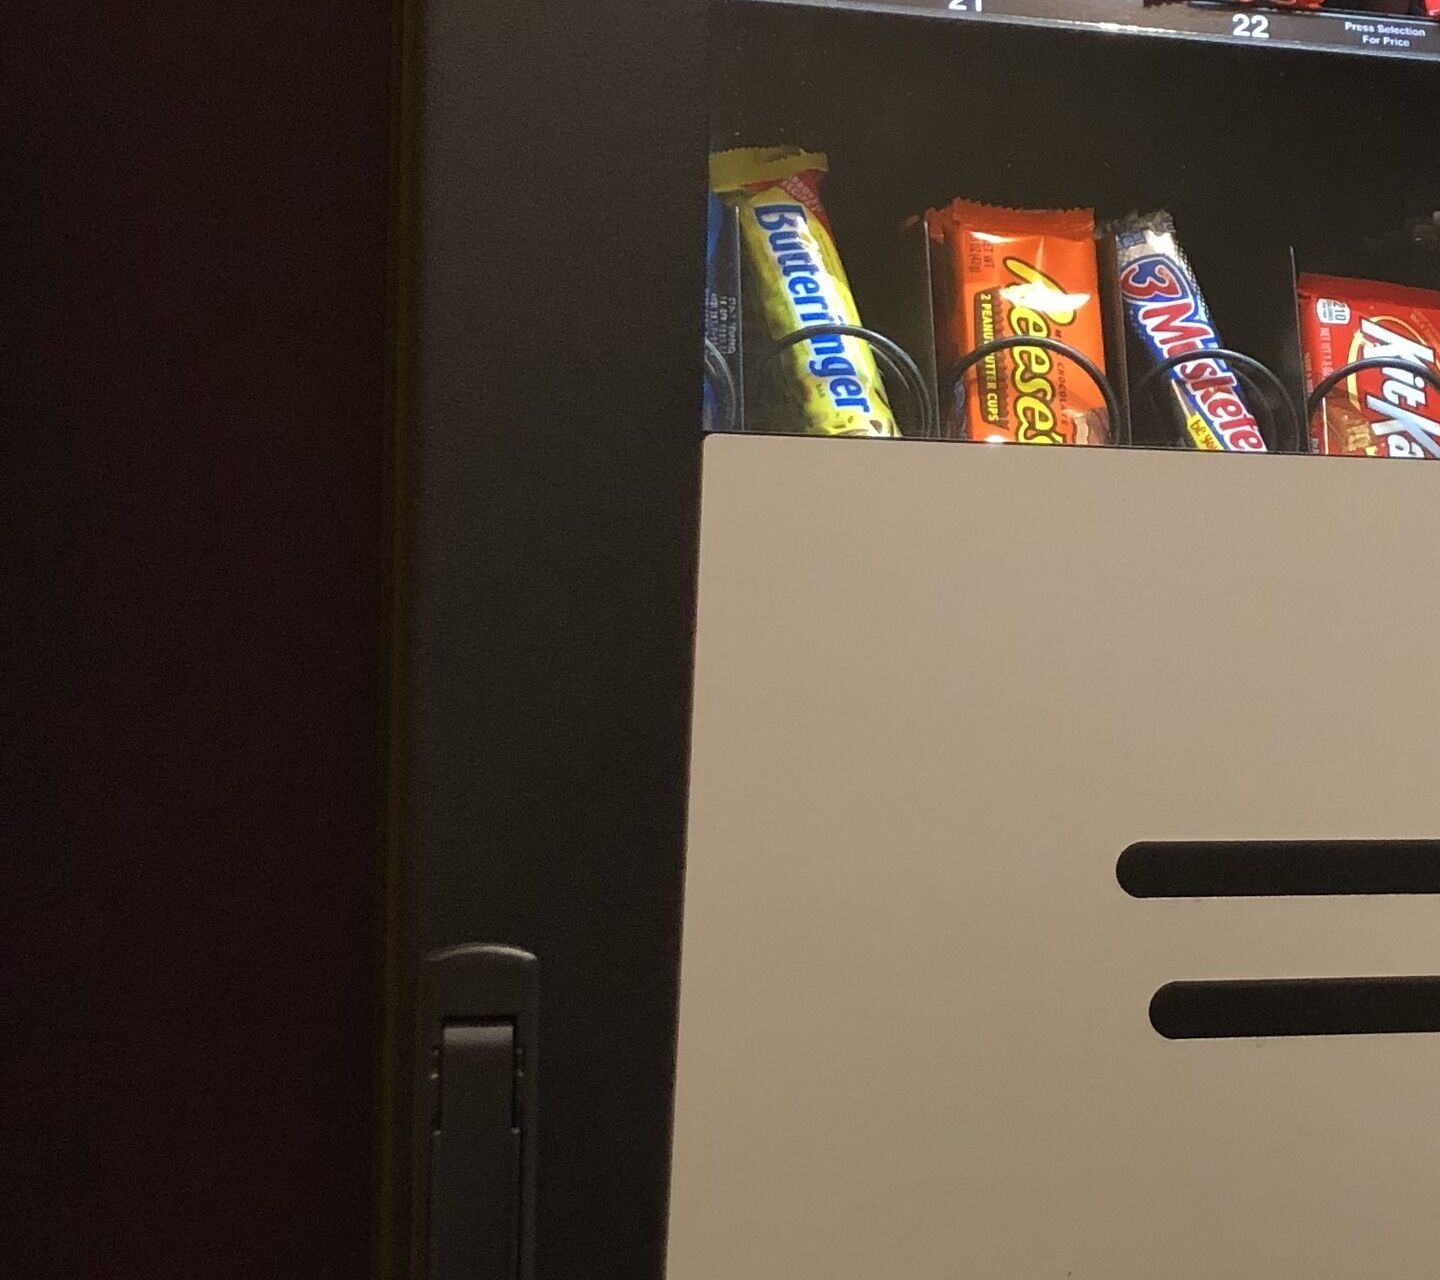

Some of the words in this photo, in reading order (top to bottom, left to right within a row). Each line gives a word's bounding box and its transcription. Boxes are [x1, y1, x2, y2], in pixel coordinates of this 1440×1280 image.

[1231, 14, 1270, 39] 22
[1344, 21, 1377, 35] Press
[1380, 24, 1426, 38] Selection
[1362, 34, 1382, 47] For
[1384, 35, 1411, 48] Price
[1121, 266, 1180, 299] 3
[1333, 301, 1347, 322] 210
[984, 352, 998, 390] UTTER
[1141, 301, 1266, 452] Muskete
[986, 392, 1000, 422] CUPS
